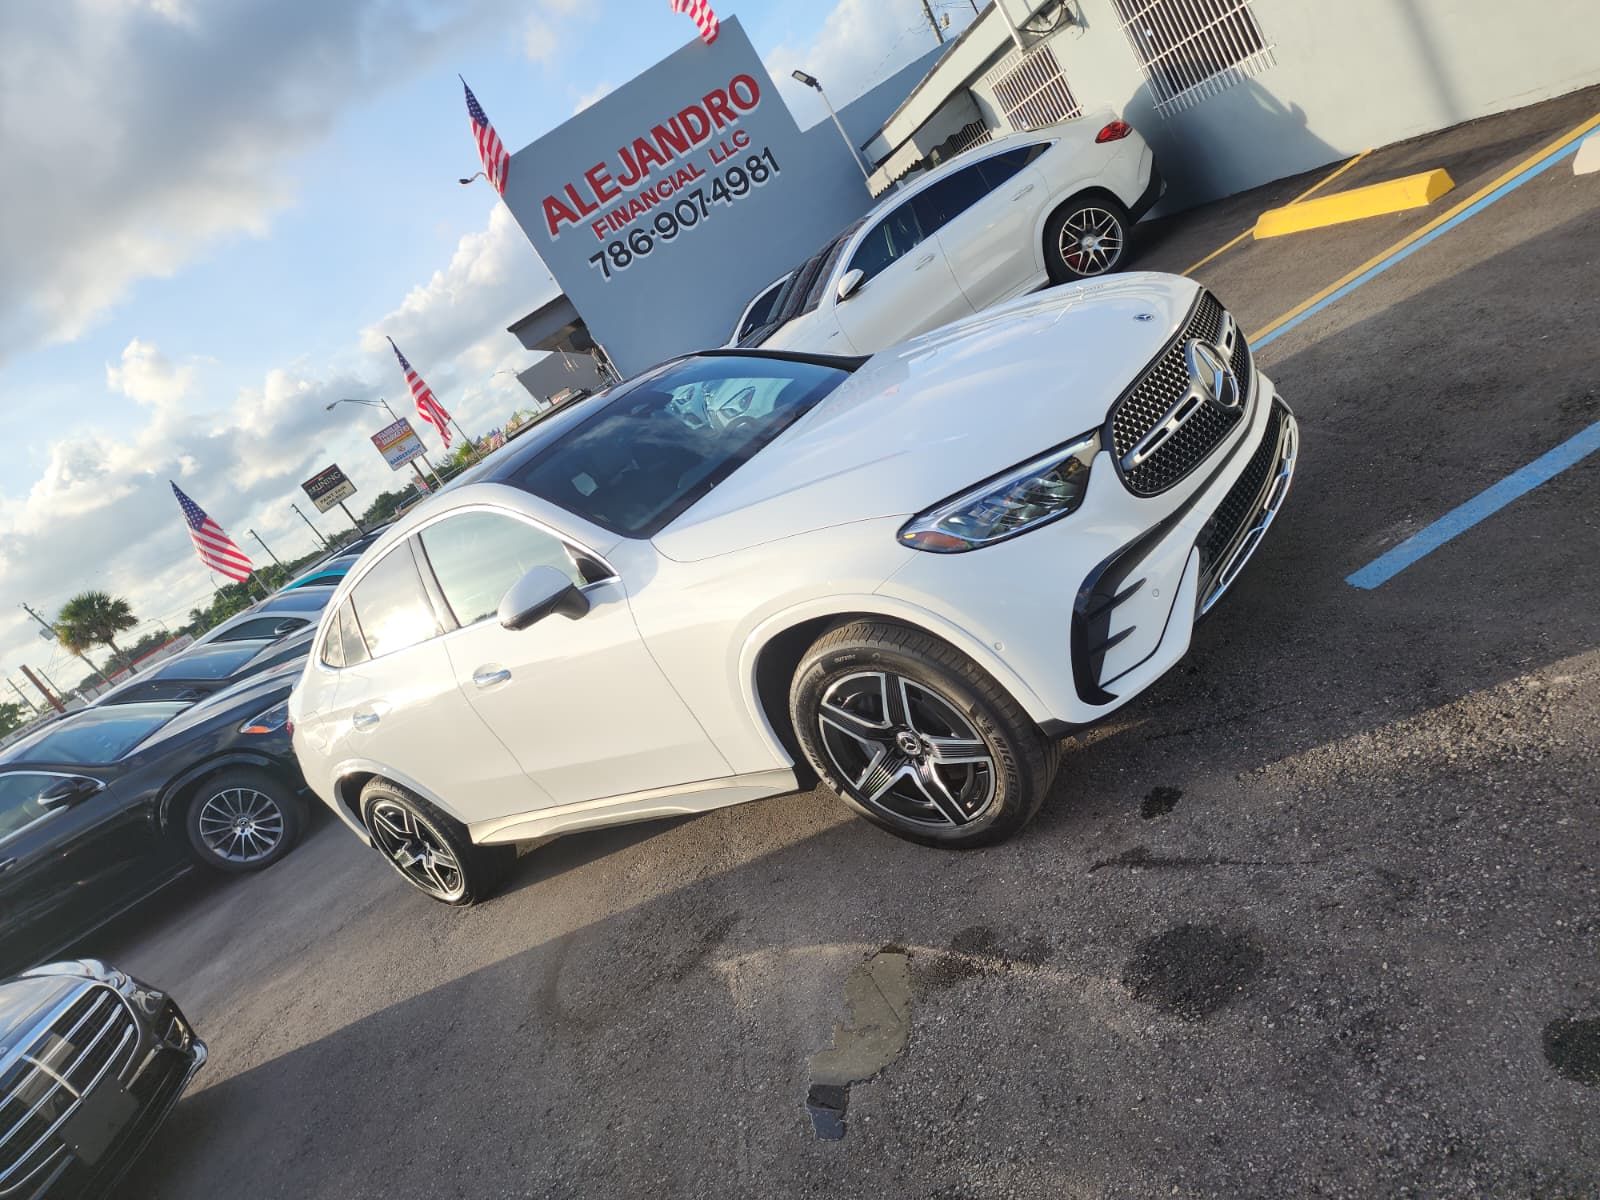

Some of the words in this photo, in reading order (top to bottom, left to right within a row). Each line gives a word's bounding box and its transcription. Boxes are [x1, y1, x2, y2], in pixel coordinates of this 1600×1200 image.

[542, 74, 761, 240] ALEJANDRO
[591, 163, 706, 241] FINANCIAL
[708, 129, 751, 167] LLC
